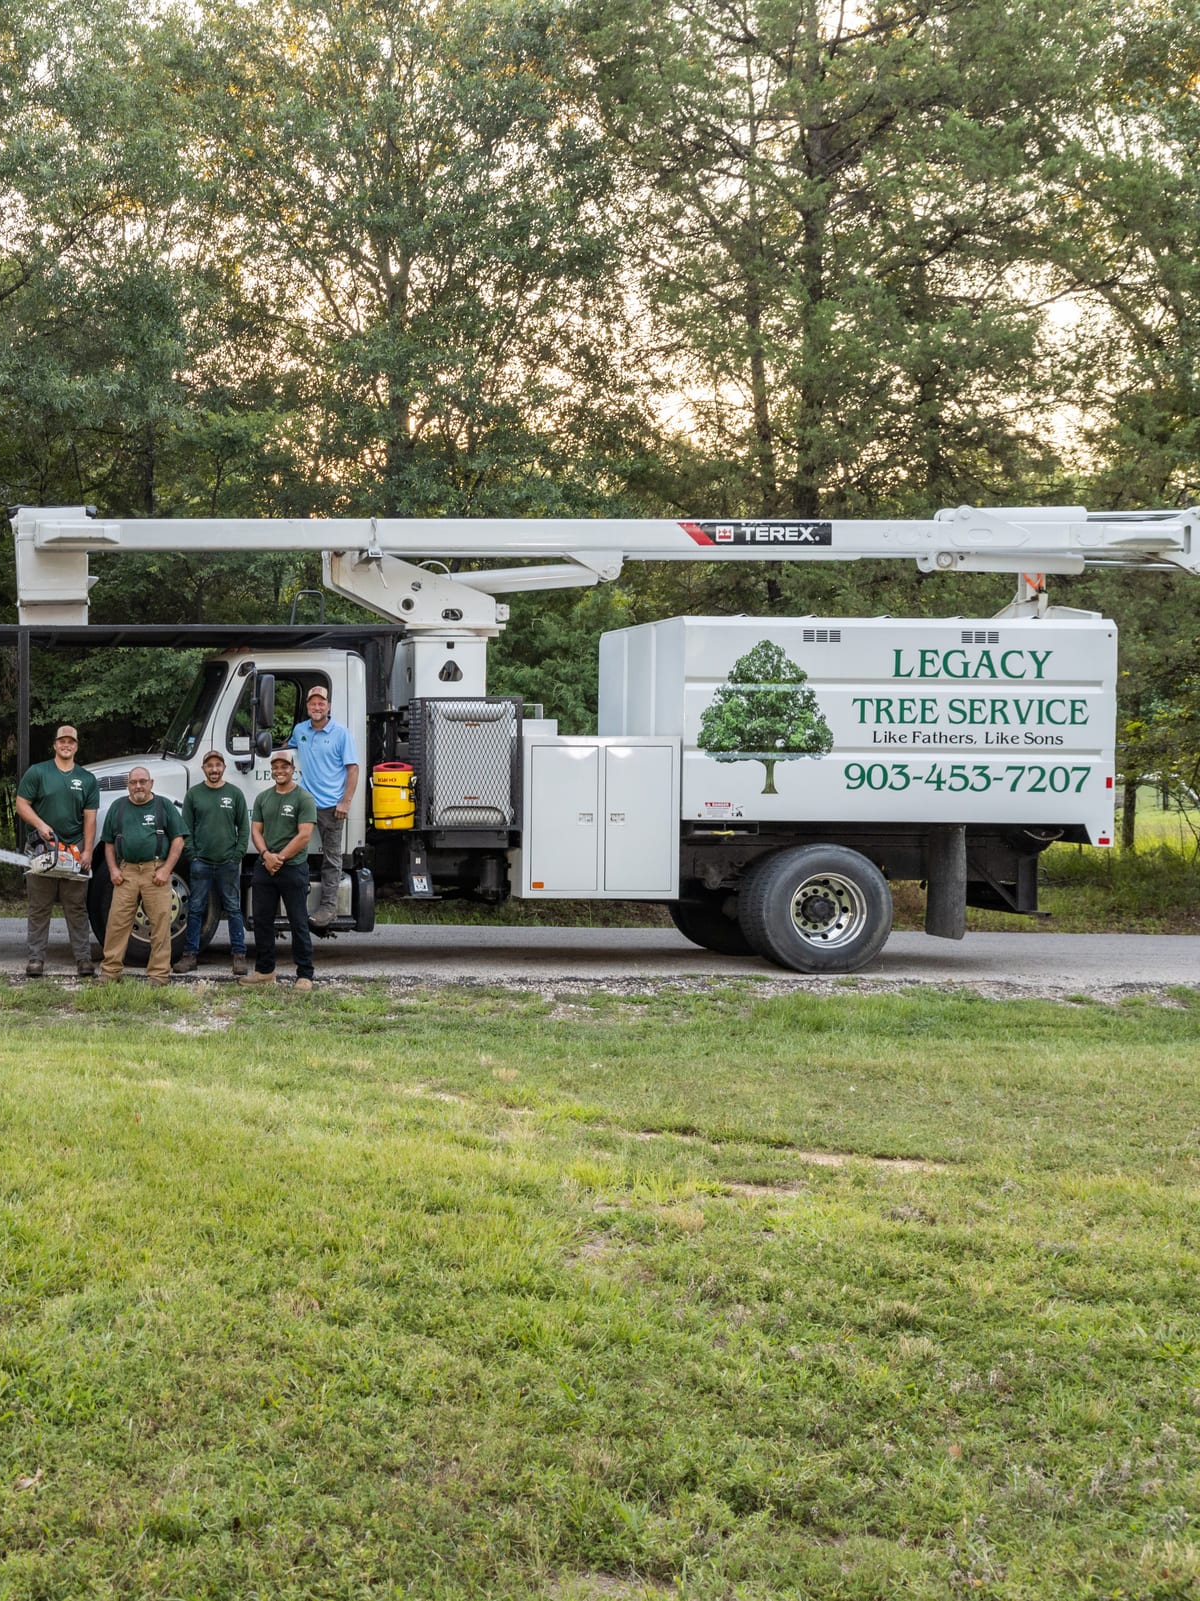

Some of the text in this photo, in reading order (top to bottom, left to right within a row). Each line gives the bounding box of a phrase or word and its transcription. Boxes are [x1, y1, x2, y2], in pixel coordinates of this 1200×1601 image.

[892, 649, 1053, 679] LEGACY
[852, 698, 1090, 725] TREE SERVICE
[872, 730, 1064, 745] Like Fathers, Like Sons
[844, 763, 1091, 793] 903-453-7207
